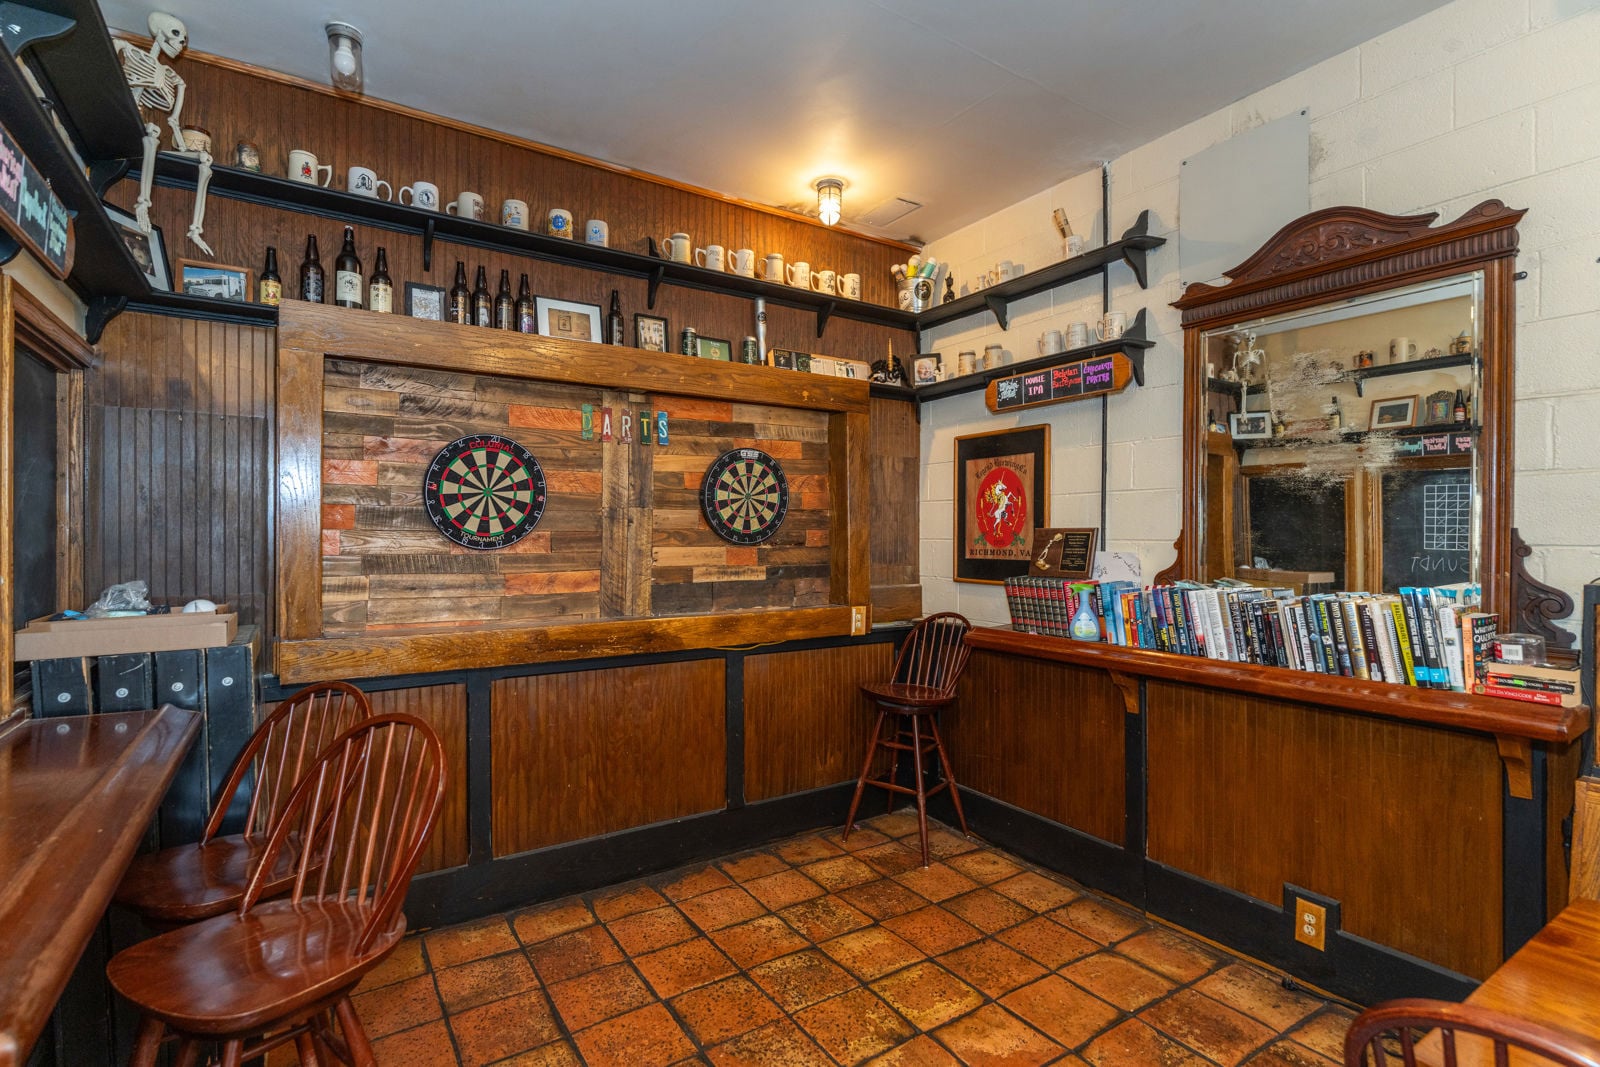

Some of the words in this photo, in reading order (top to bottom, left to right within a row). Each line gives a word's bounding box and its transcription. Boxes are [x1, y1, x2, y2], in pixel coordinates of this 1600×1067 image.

[1026, 375, 1045, 384] DOUBLE
[1053, 368, 1078, 380] Belgian
[1086, 372, 1110, 385] PORTER
[1028, 386, 1044, 396] IPA
[582, 411, 668, 439] DARTS
[460, 532, 505, 542] TOURNAMENT
[970, 549, 1016, 557] RICHMOND,
[1020, 548, 1031, 556] VA
[1330, 601, 1340, 618] DAVID
[1229, 604, 1242, 633] BAUER
[1393, 603, 1407, 643] BRAZILLIONAIRES
[1333, 617, 1345, 643] BALDACCI
